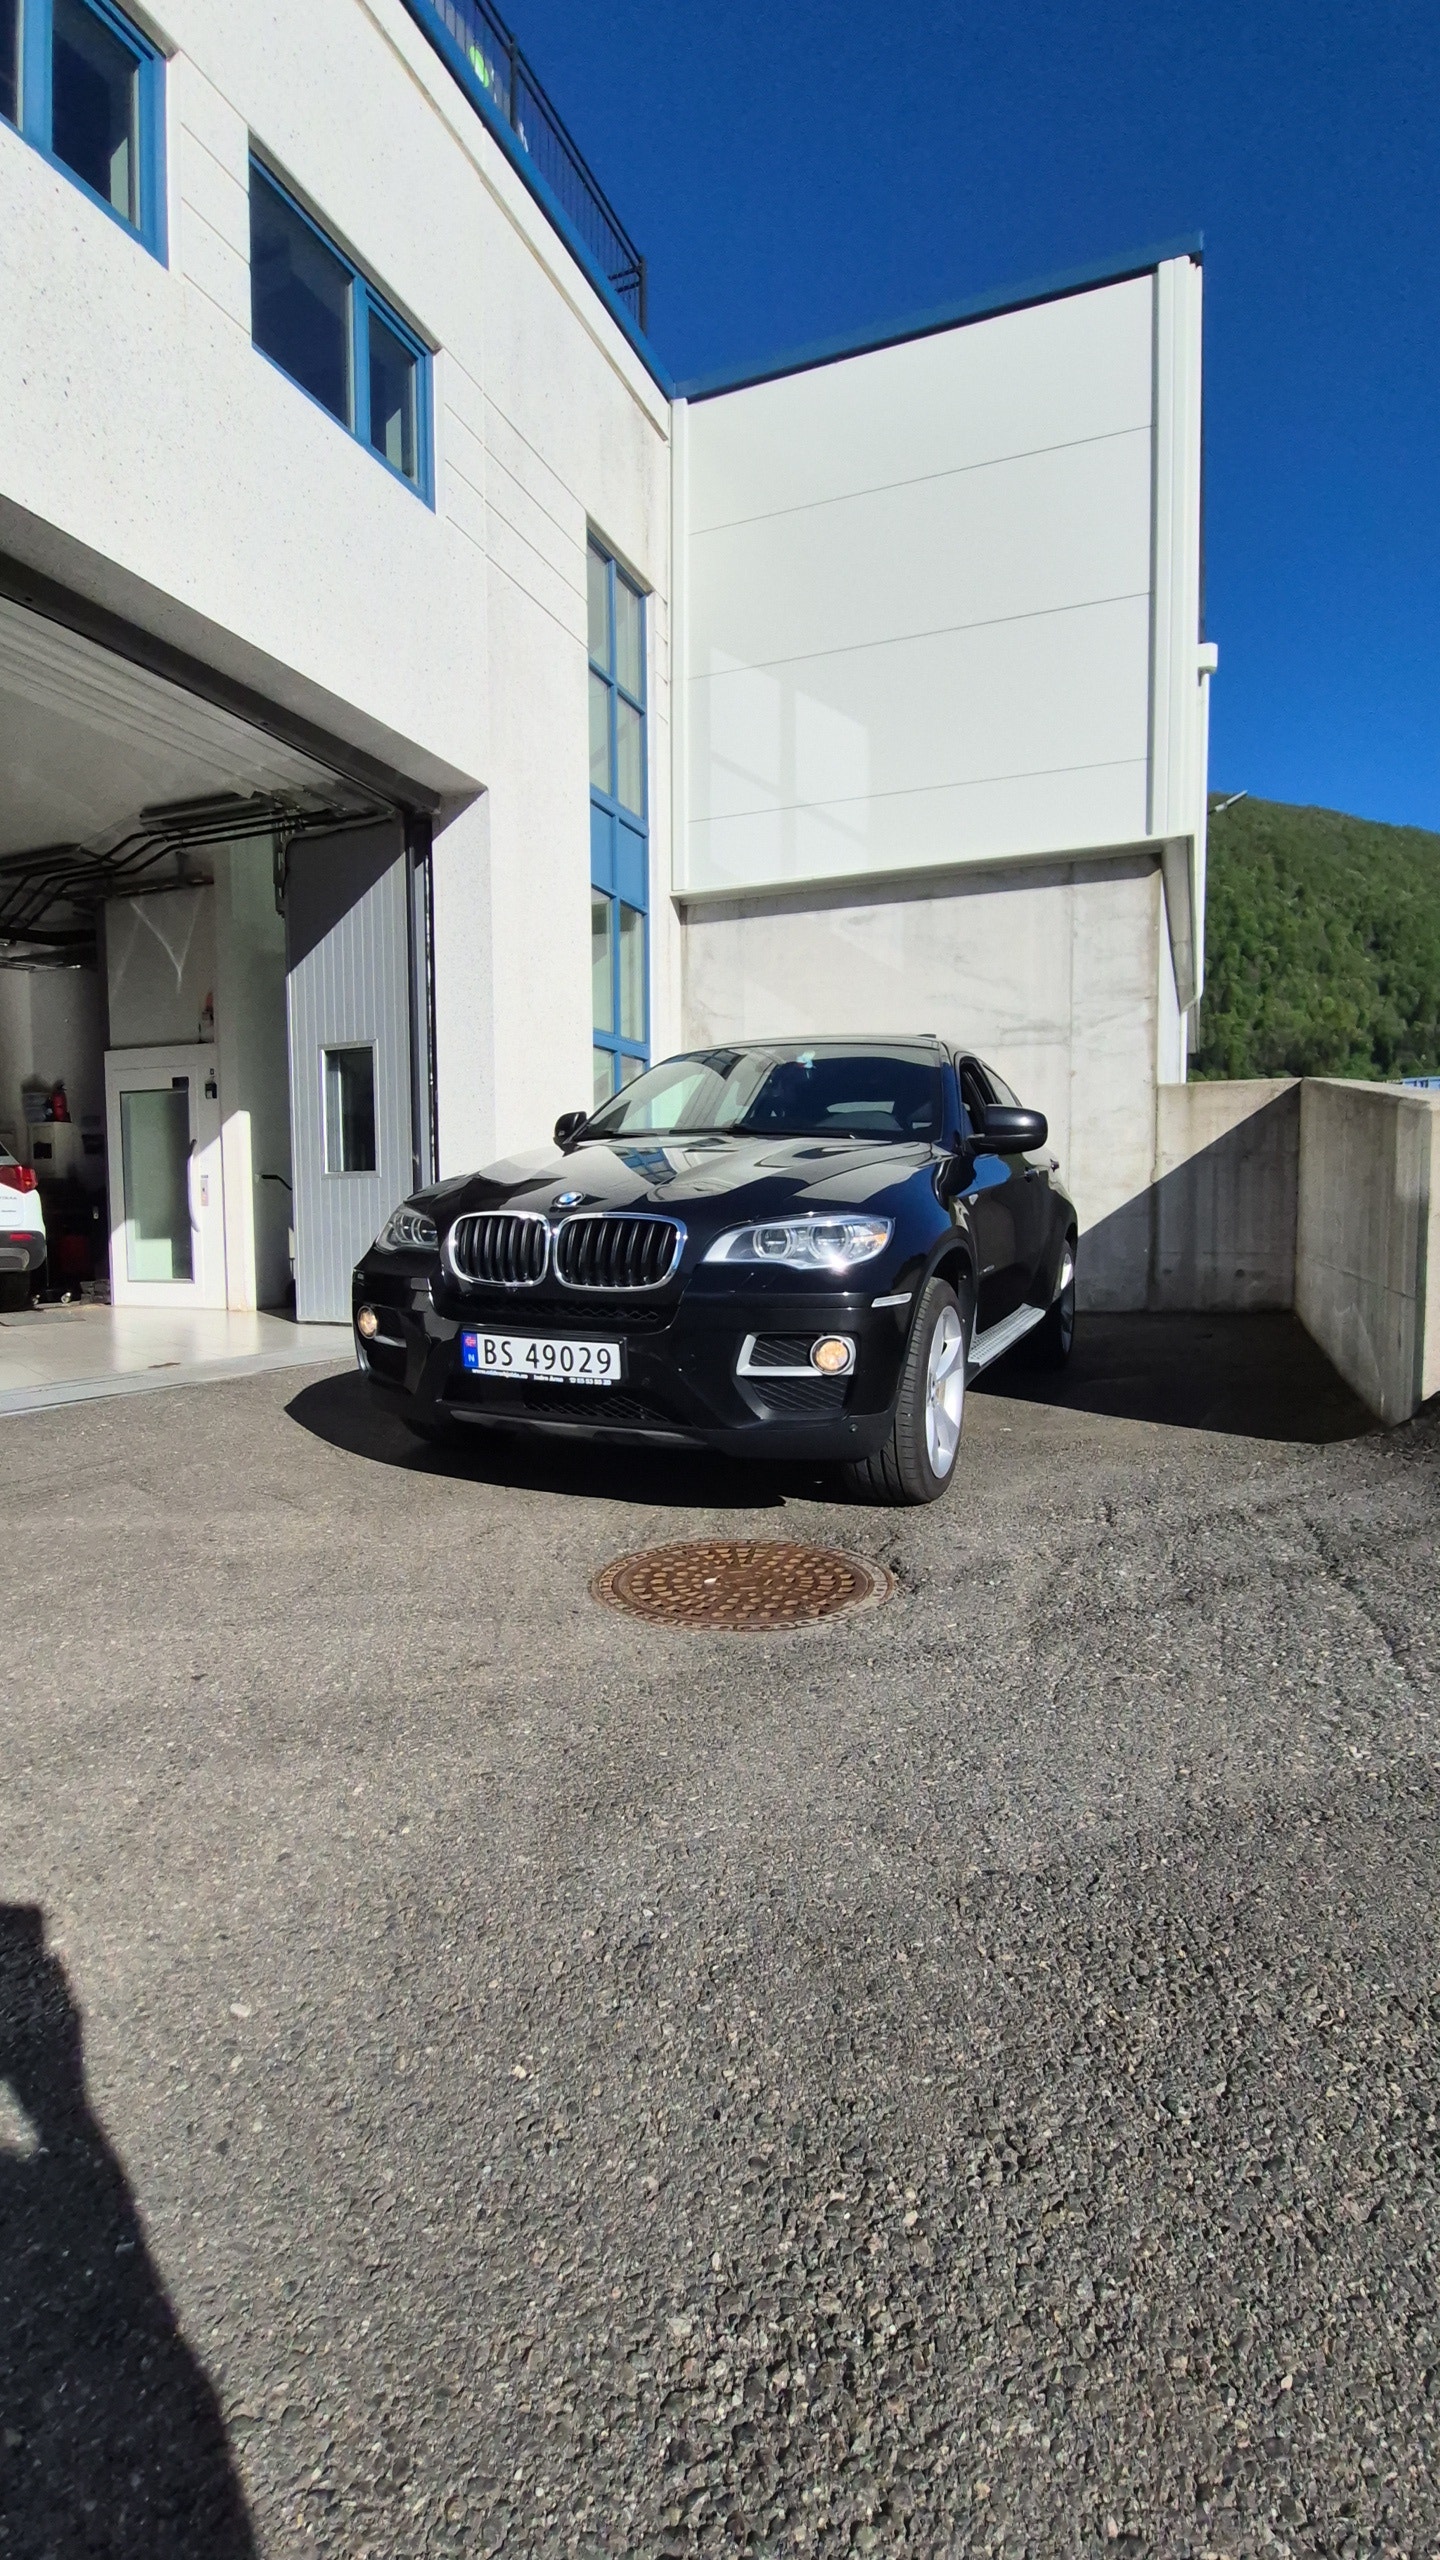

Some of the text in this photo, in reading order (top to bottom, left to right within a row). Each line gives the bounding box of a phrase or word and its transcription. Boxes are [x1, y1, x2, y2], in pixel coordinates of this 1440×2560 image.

[468, 1353, 475, 1362] N
[484, 1339, 612, 1374] BS 49029
